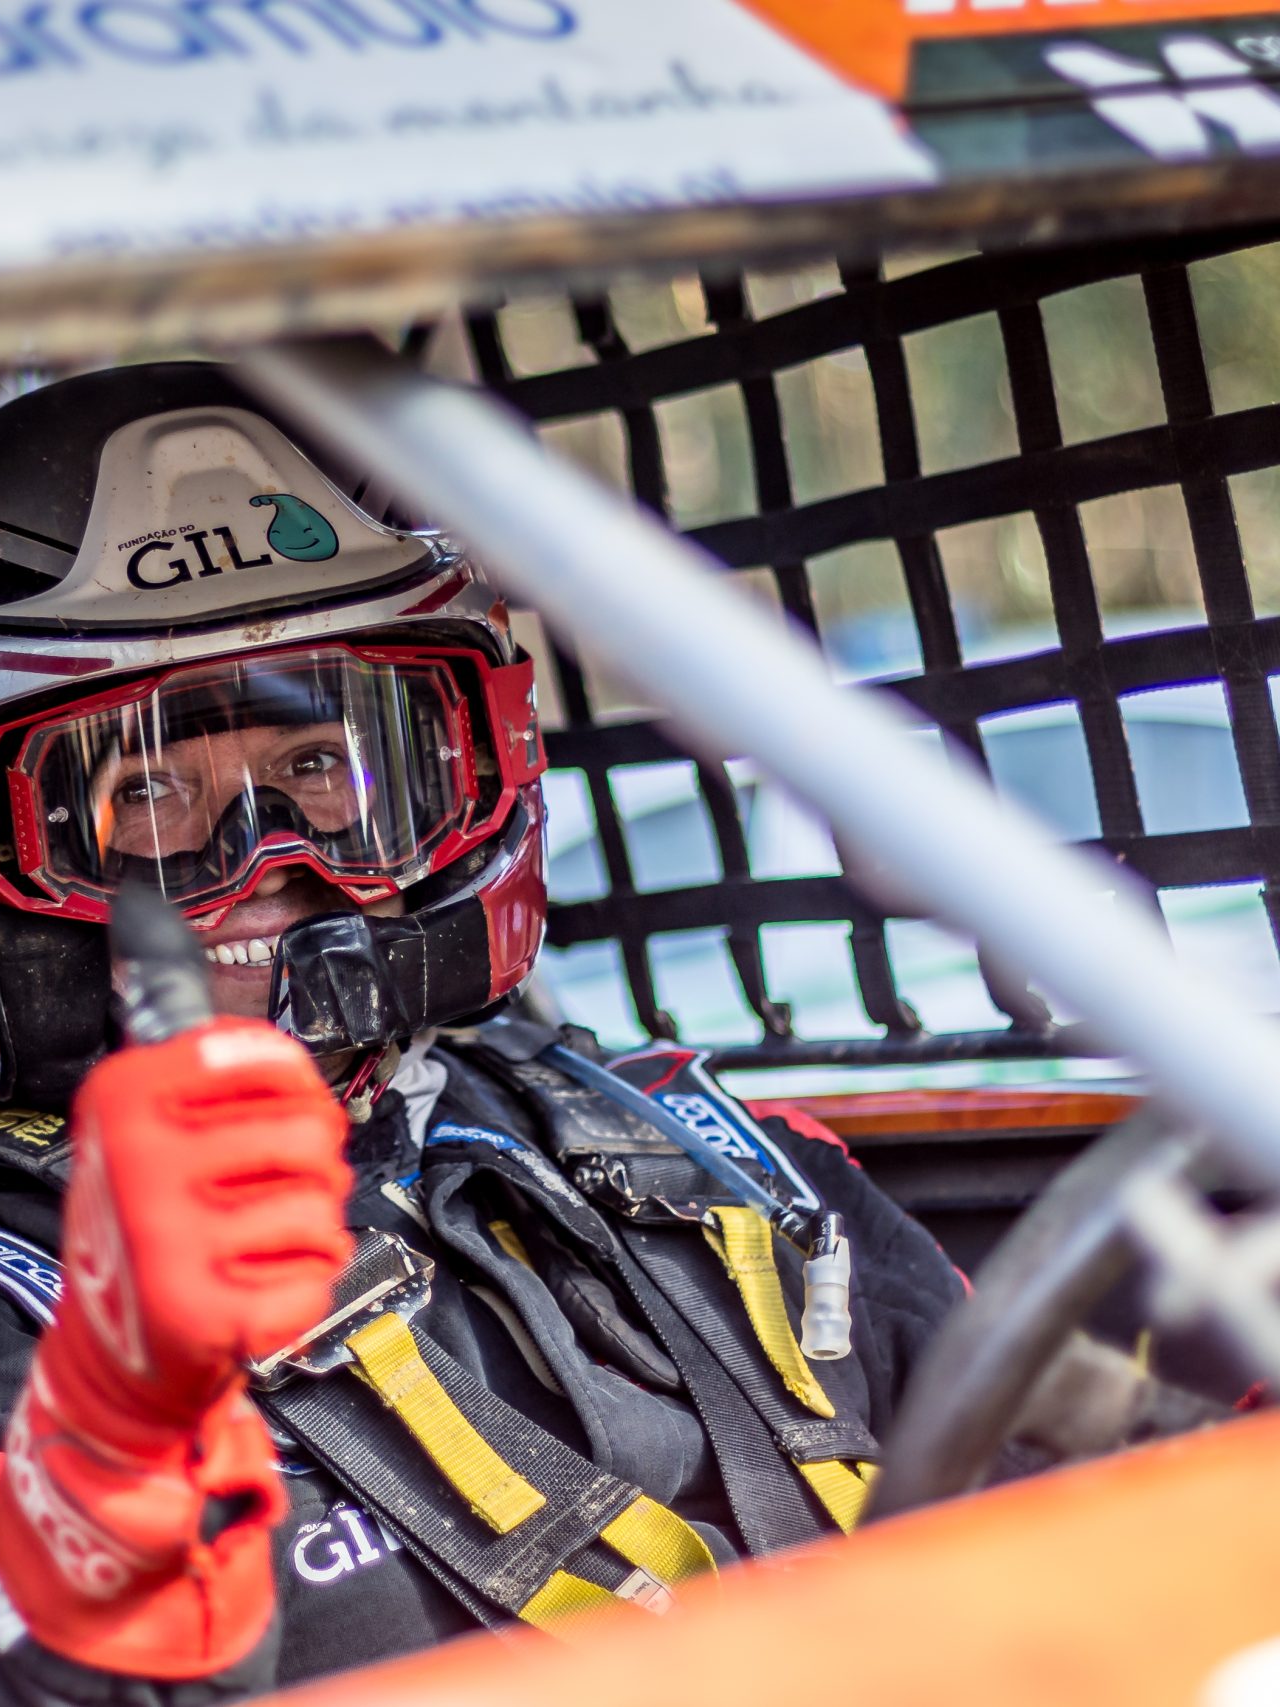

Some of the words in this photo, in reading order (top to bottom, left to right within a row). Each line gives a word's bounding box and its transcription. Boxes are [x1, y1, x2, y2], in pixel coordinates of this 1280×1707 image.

[117, 529, 177, 552] FUNDAÇÃO
[178, 524, 196, 534] DO
[126, 526, 274, 591] GIL
